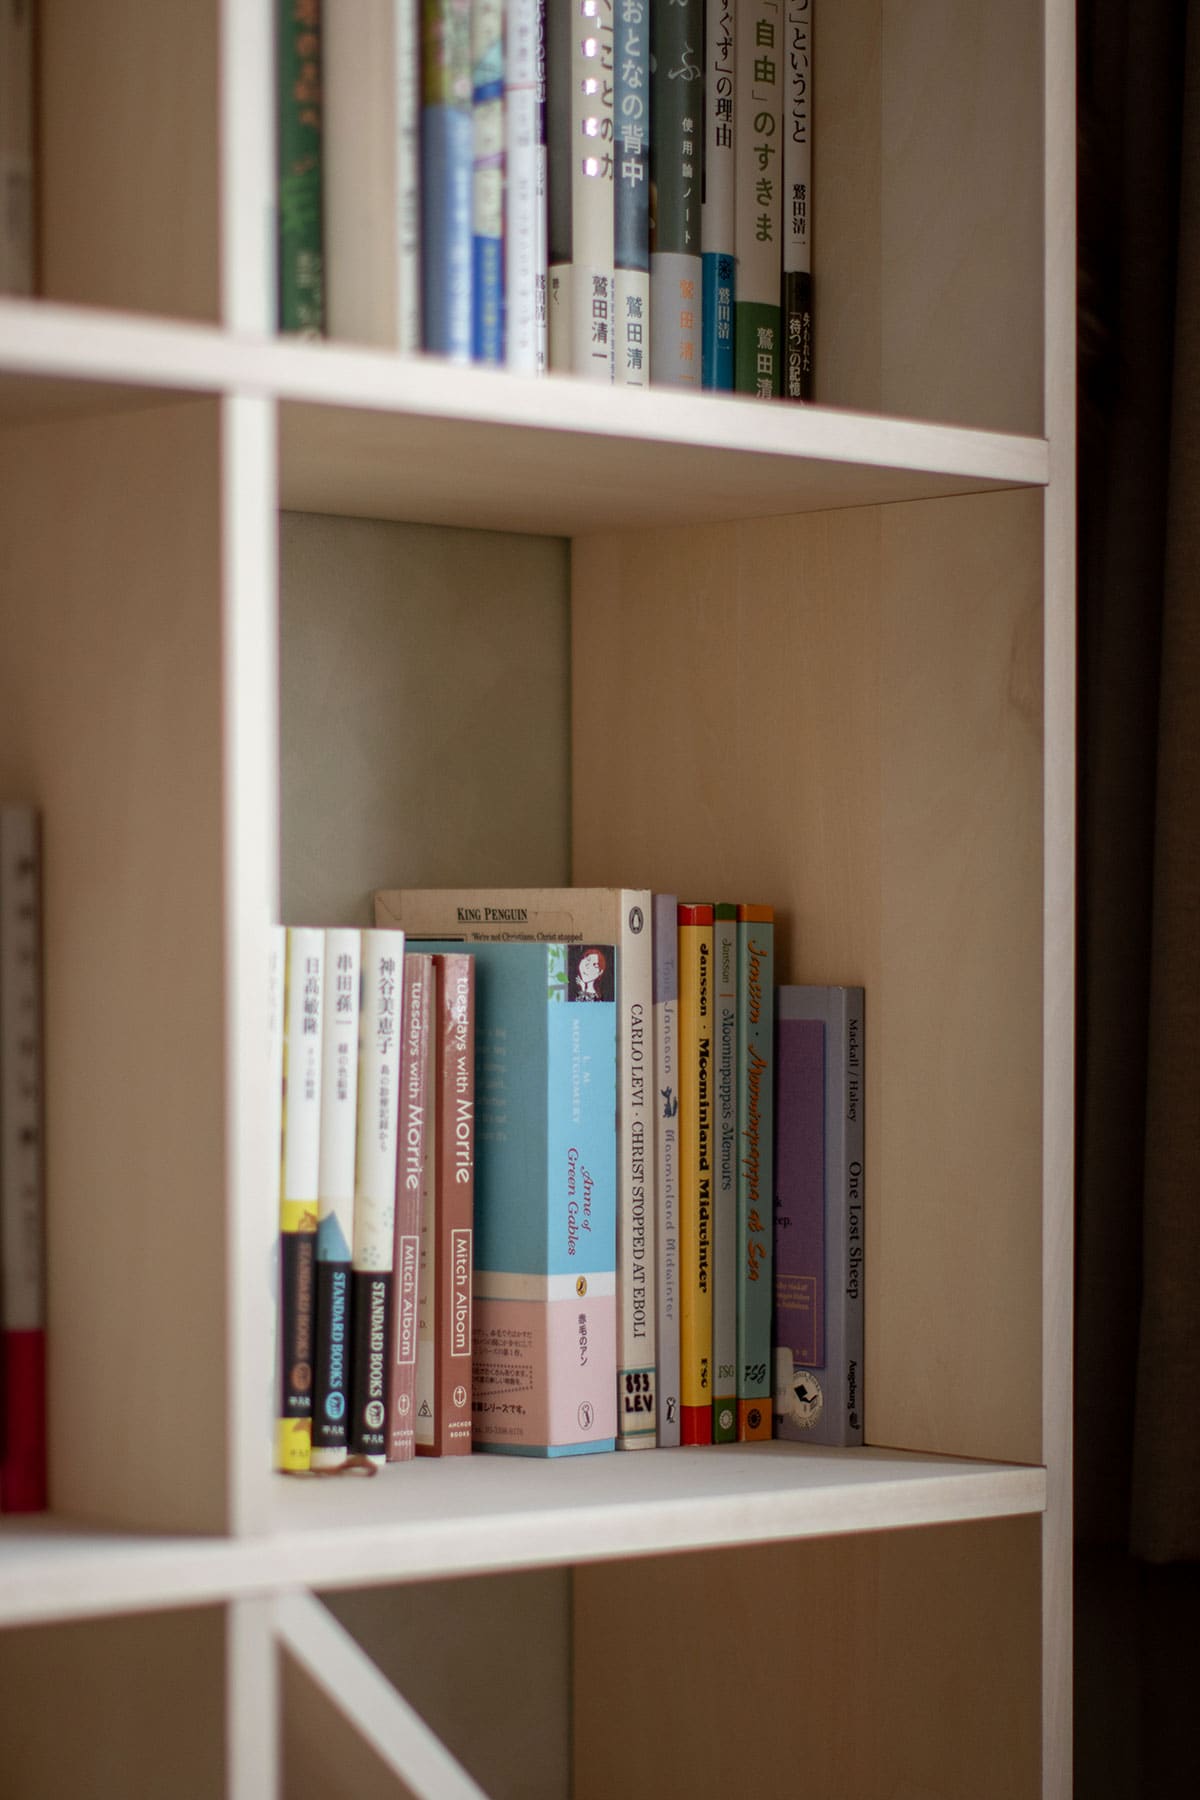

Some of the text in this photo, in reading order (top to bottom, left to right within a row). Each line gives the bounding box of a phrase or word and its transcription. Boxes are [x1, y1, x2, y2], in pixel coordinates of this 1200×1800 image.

[751, 2, 779, 243] 「自由」のすきま
[792, 184, 806, 246] 鷲田清一
[592, 275, 608, 359] 鷲田清一
[626, 295, 643, 387] 鷲田清一
[680, 280, 694, 381] 鷲田清一
[718, 288, 731, 350] 鷲田清一
[457, 908, 528, 921] KING PENGUIN
[336, 954, 352, 1025] 串田孫一
[377, 957, 395, 1055] 神谷美恵子
[664, 1000, 674, 1074] Jansson
[406, 982, 424, 1190] tuesdays with Morrie
[455, 977, 474, 1184] tuesdays with Morrie
[719, 937, 734, 1191] Jansson Moominpappa's Memoirs
[742, 940, 768, 1281] Jansson Moominpappa at Sea
[847, 1018, 861, 1122] Mackall Halsey
[698, 942, 710, 1293] Jansson Moominland Midwinter
[567, 1148, 579, 1256] Green Gables
[580, 1165, 594, 1232] Anne of
[630, 1003, 646, 1338] CARLO LEVI CHRIST STOPPED AT EBOLI
[664, 1129, 677, 1321] Moominland Midwinter
[846, 1161, 862, 1299] One Lost Sheep
[329, 1271, 346, 1388] STANDARD BOOKS
[368, 1281, 385, 1398] STANDARD BOOKS
[401, 1244, 415, 1357] Mitch Albom
[456, 1238, 468, 1348] Mitch Albom
[577, 1313, 589, 1366] 赤毛のアン
[473, 1402, 527, 1415] シリーズです。
[625, 1395, 653, 1413] LEV
[626, 1374, 650, 1393] 853
[718, 1365, 735, 1379] FSG
[744, 1364, 767, 1385] FSG
[848, 1359, 858, 1410] Augsburg
